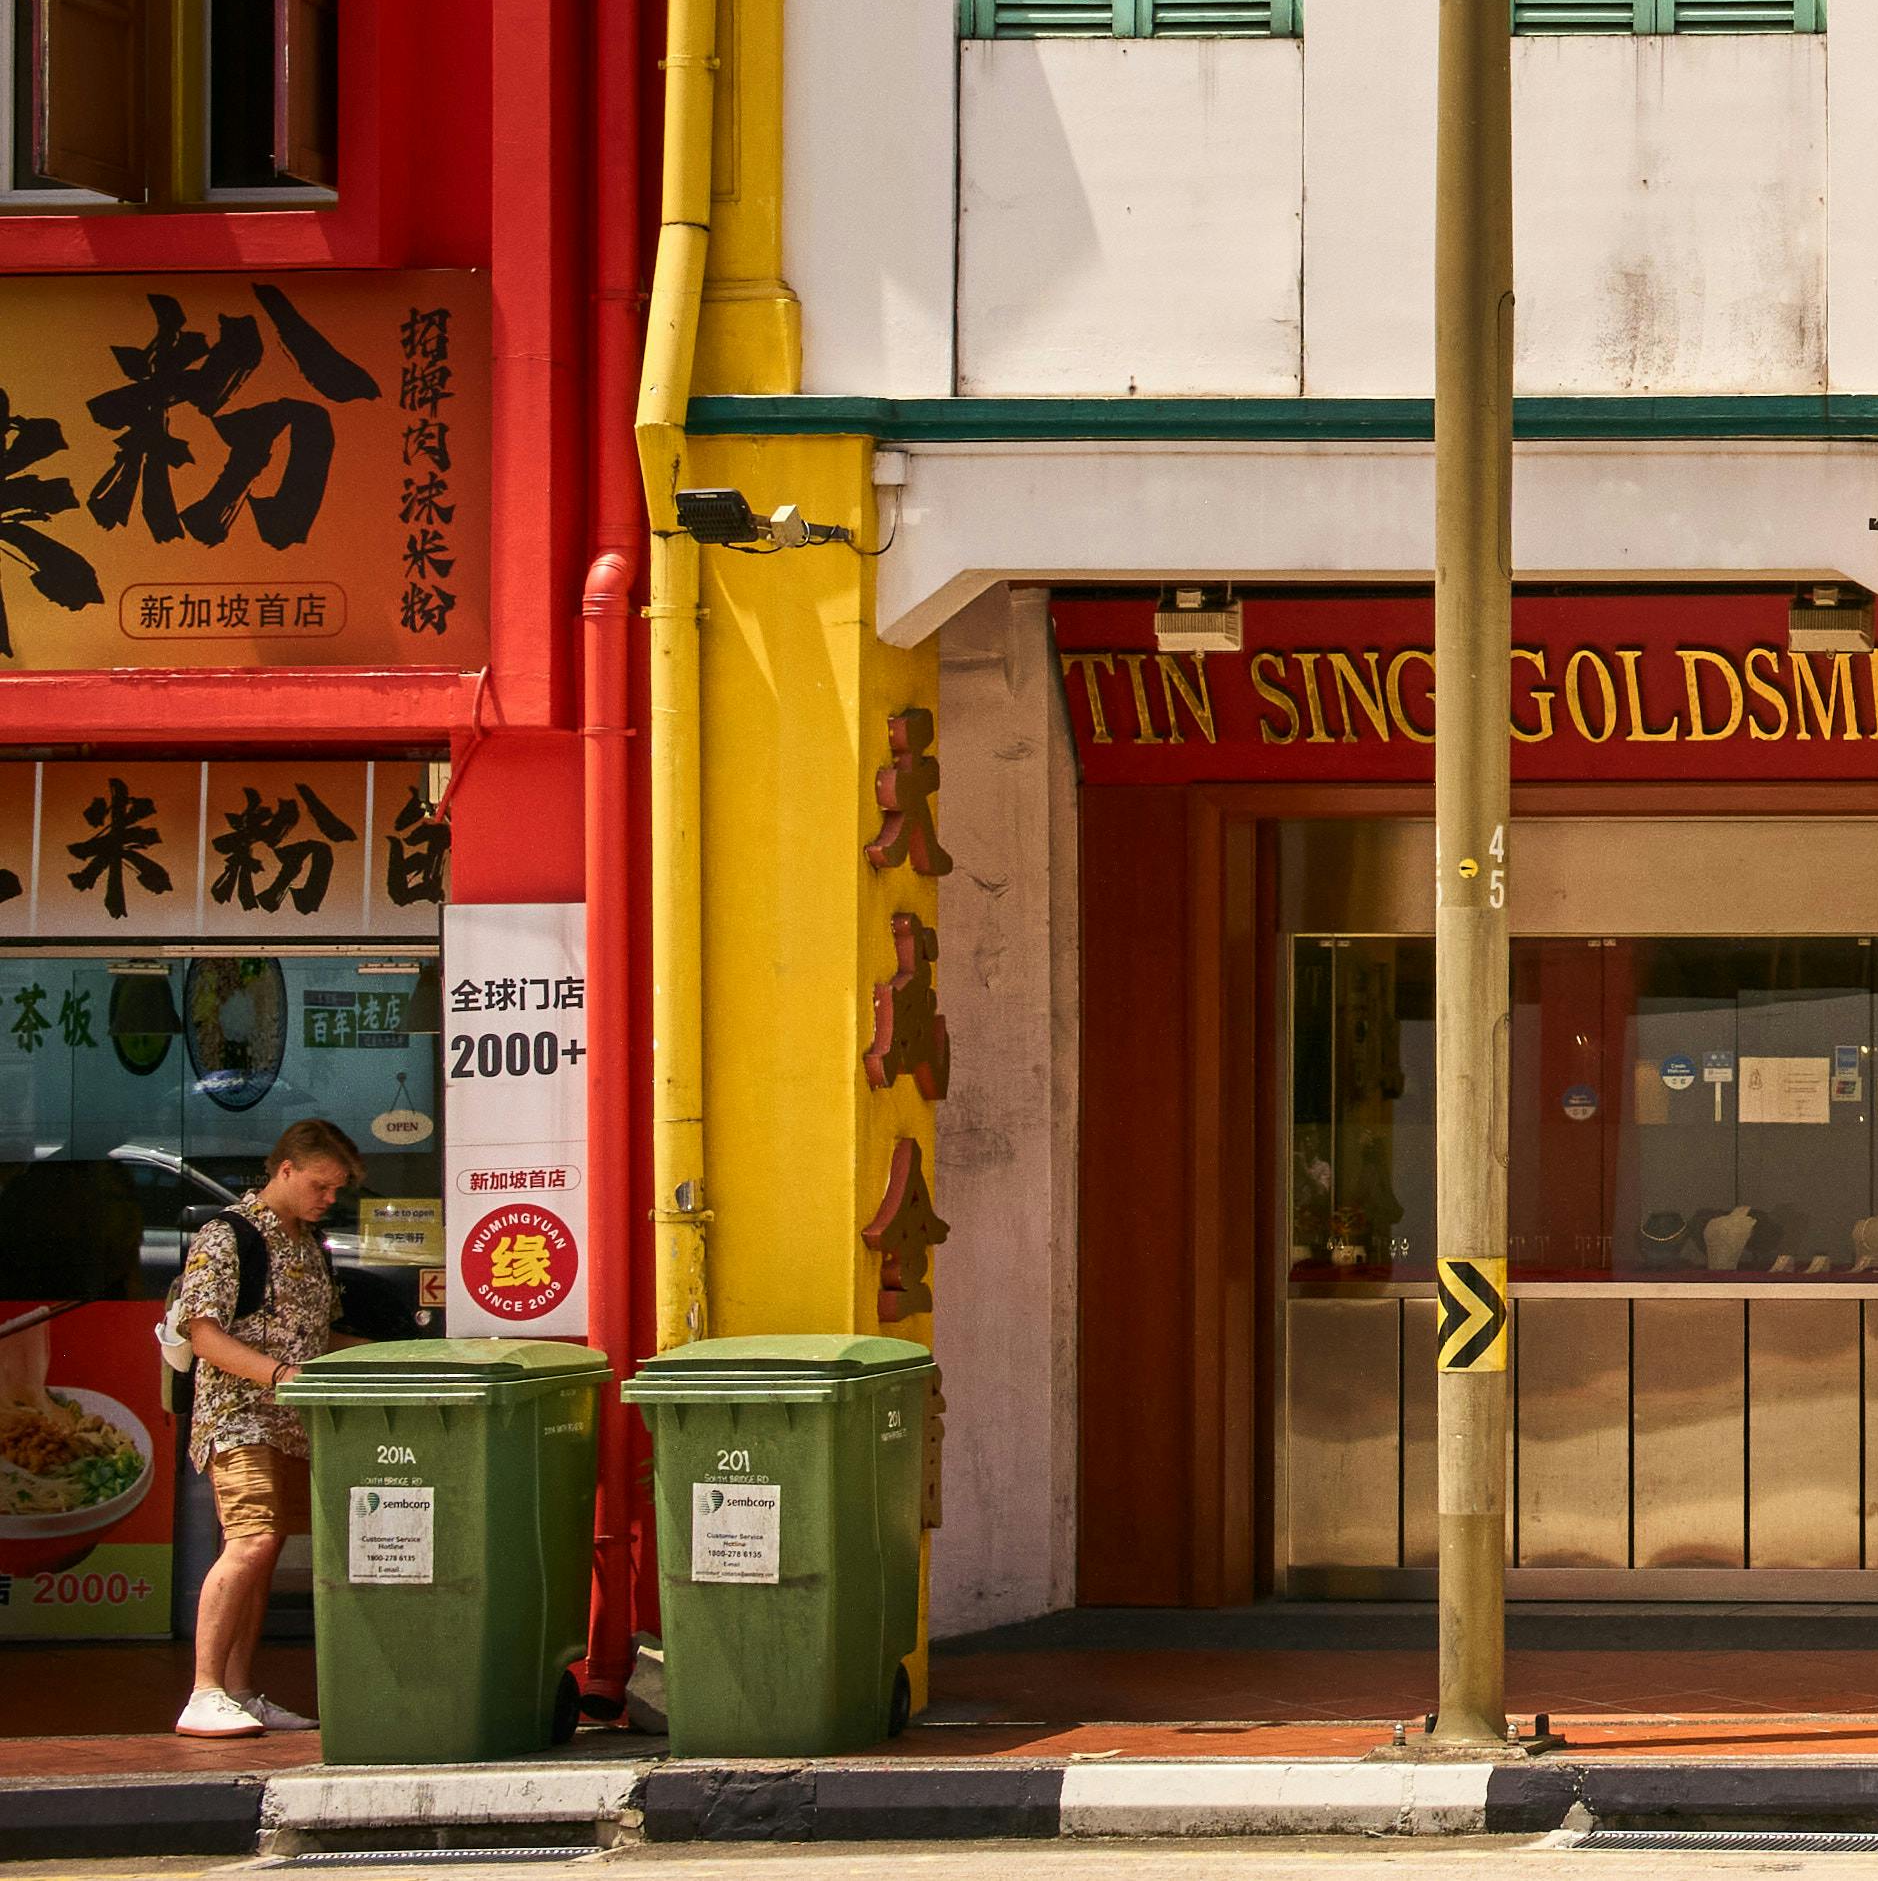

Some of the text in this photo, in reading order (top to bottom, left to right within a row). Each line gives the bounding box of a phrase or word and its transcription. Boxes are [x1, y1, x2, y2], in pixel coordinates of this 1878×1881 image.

[140, 592, 327, 629] 新加坡首店
[1062, 651, 1218, 745] TIN
[450, 976, 585, 1013] 全球门店
[0, 982, 98, 1053] 茶饭
[450, 1030, 586, 1079] 2000+
[386, 1121, 419, 1133] OPEN
[469, 1168, 567, 1193] 新加坡首店
[374, 1208, 400, 1218] Swe
[472, 1212, 567, 1254] WUMINGYUAN
[490, 1234, 552, 1288] 缘
[478, 1280, 563, 1313] SINCE 2009
[888, 1409, 901, 1428] 201
[377, 1445, 417, 1465] 201A
[717, 1449, 751, 1473] 201
[383, 1499, 431, 1511] sembcorp
[726, 1496, 775, 1510] sembcorp
[361, 1535, 421, 1543] Customer Service
[32, 1572, 153, 1607] 2000+
